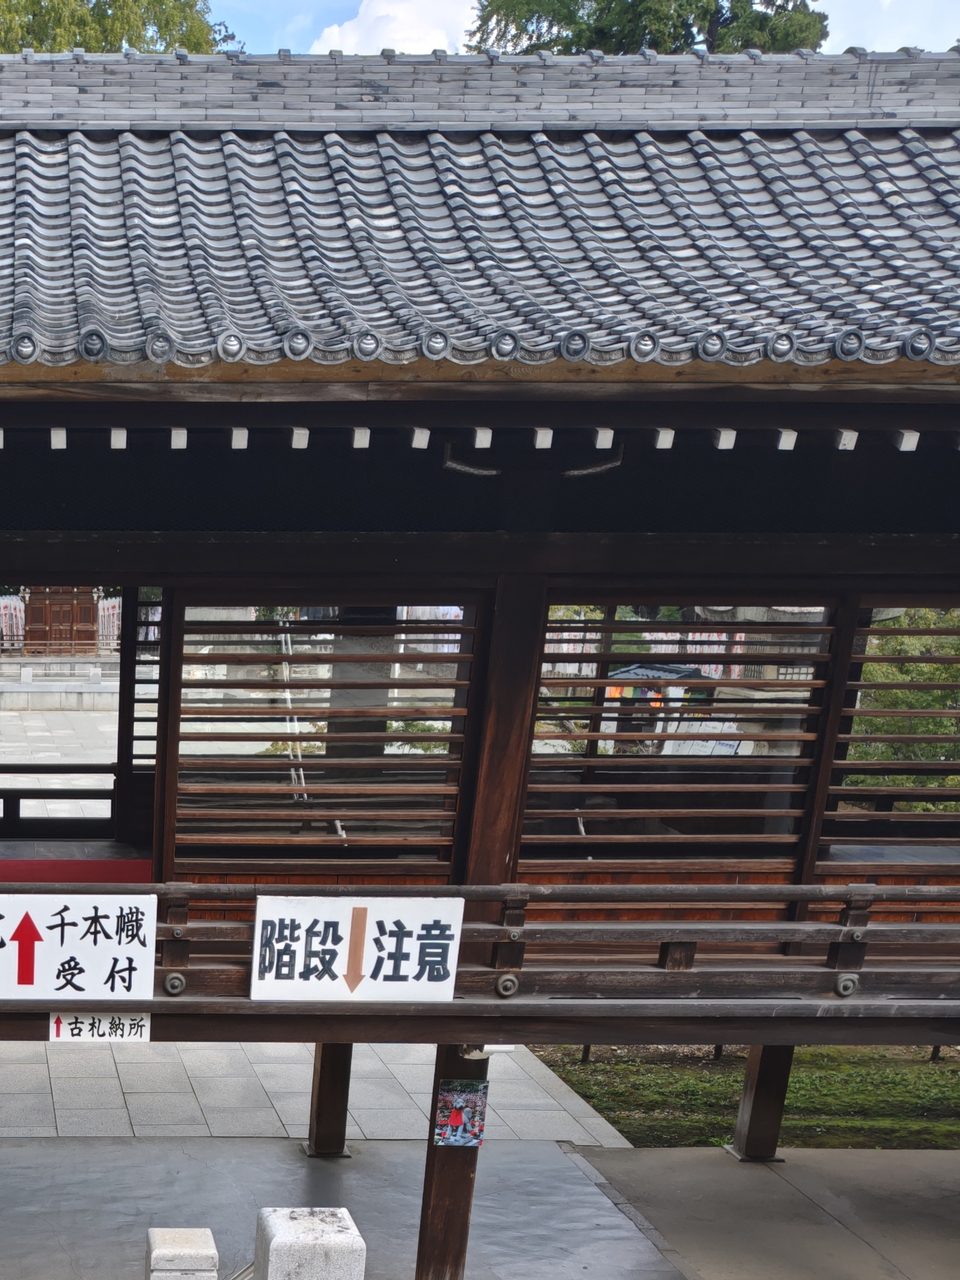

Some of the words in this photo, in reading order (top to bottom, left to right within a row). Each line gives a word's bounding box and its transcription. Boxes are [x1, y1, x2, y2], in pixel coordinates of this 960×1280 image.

[46, 905, 147, 948] 千本幟
[258, 918, 344, 981] 階段
[370, 919, 455, 982] 注意
[55, 956, 137, 992] 受付
[67, 1015, 146, 1038] 古札納所
